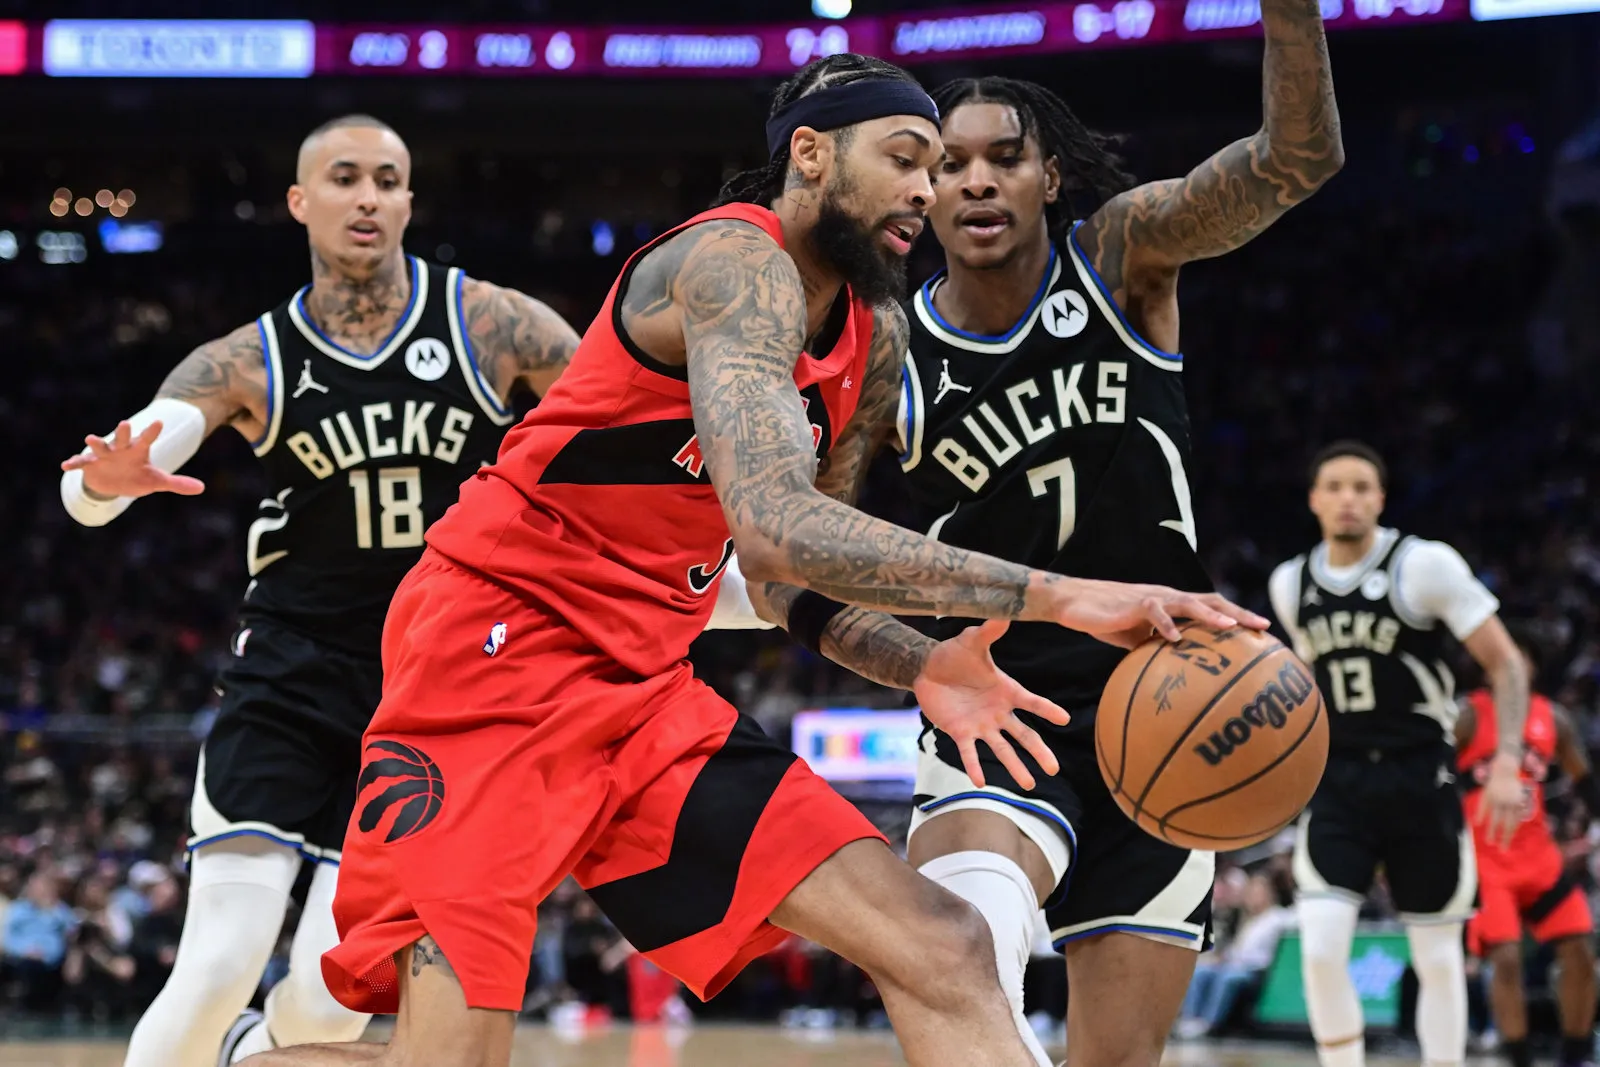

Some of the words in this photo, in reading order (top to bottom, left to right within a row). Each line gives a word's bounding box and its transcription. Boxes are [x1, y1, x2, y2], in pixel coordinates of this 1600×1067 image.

[75, 27, 286, 66] TORONTO
[418, 30, 448, 69] 2
[545, 31, 575, 70] 6
[286, 400, 474, 480] BUCKS
[931, 361, 1128, 493] BUCKS
[348, 466, 424, 549] 18
[1026, 457, 1076, 551] 7
[1192, 659, 1313, 767] Wilson
[1327, 656, 1377, 714] 13
